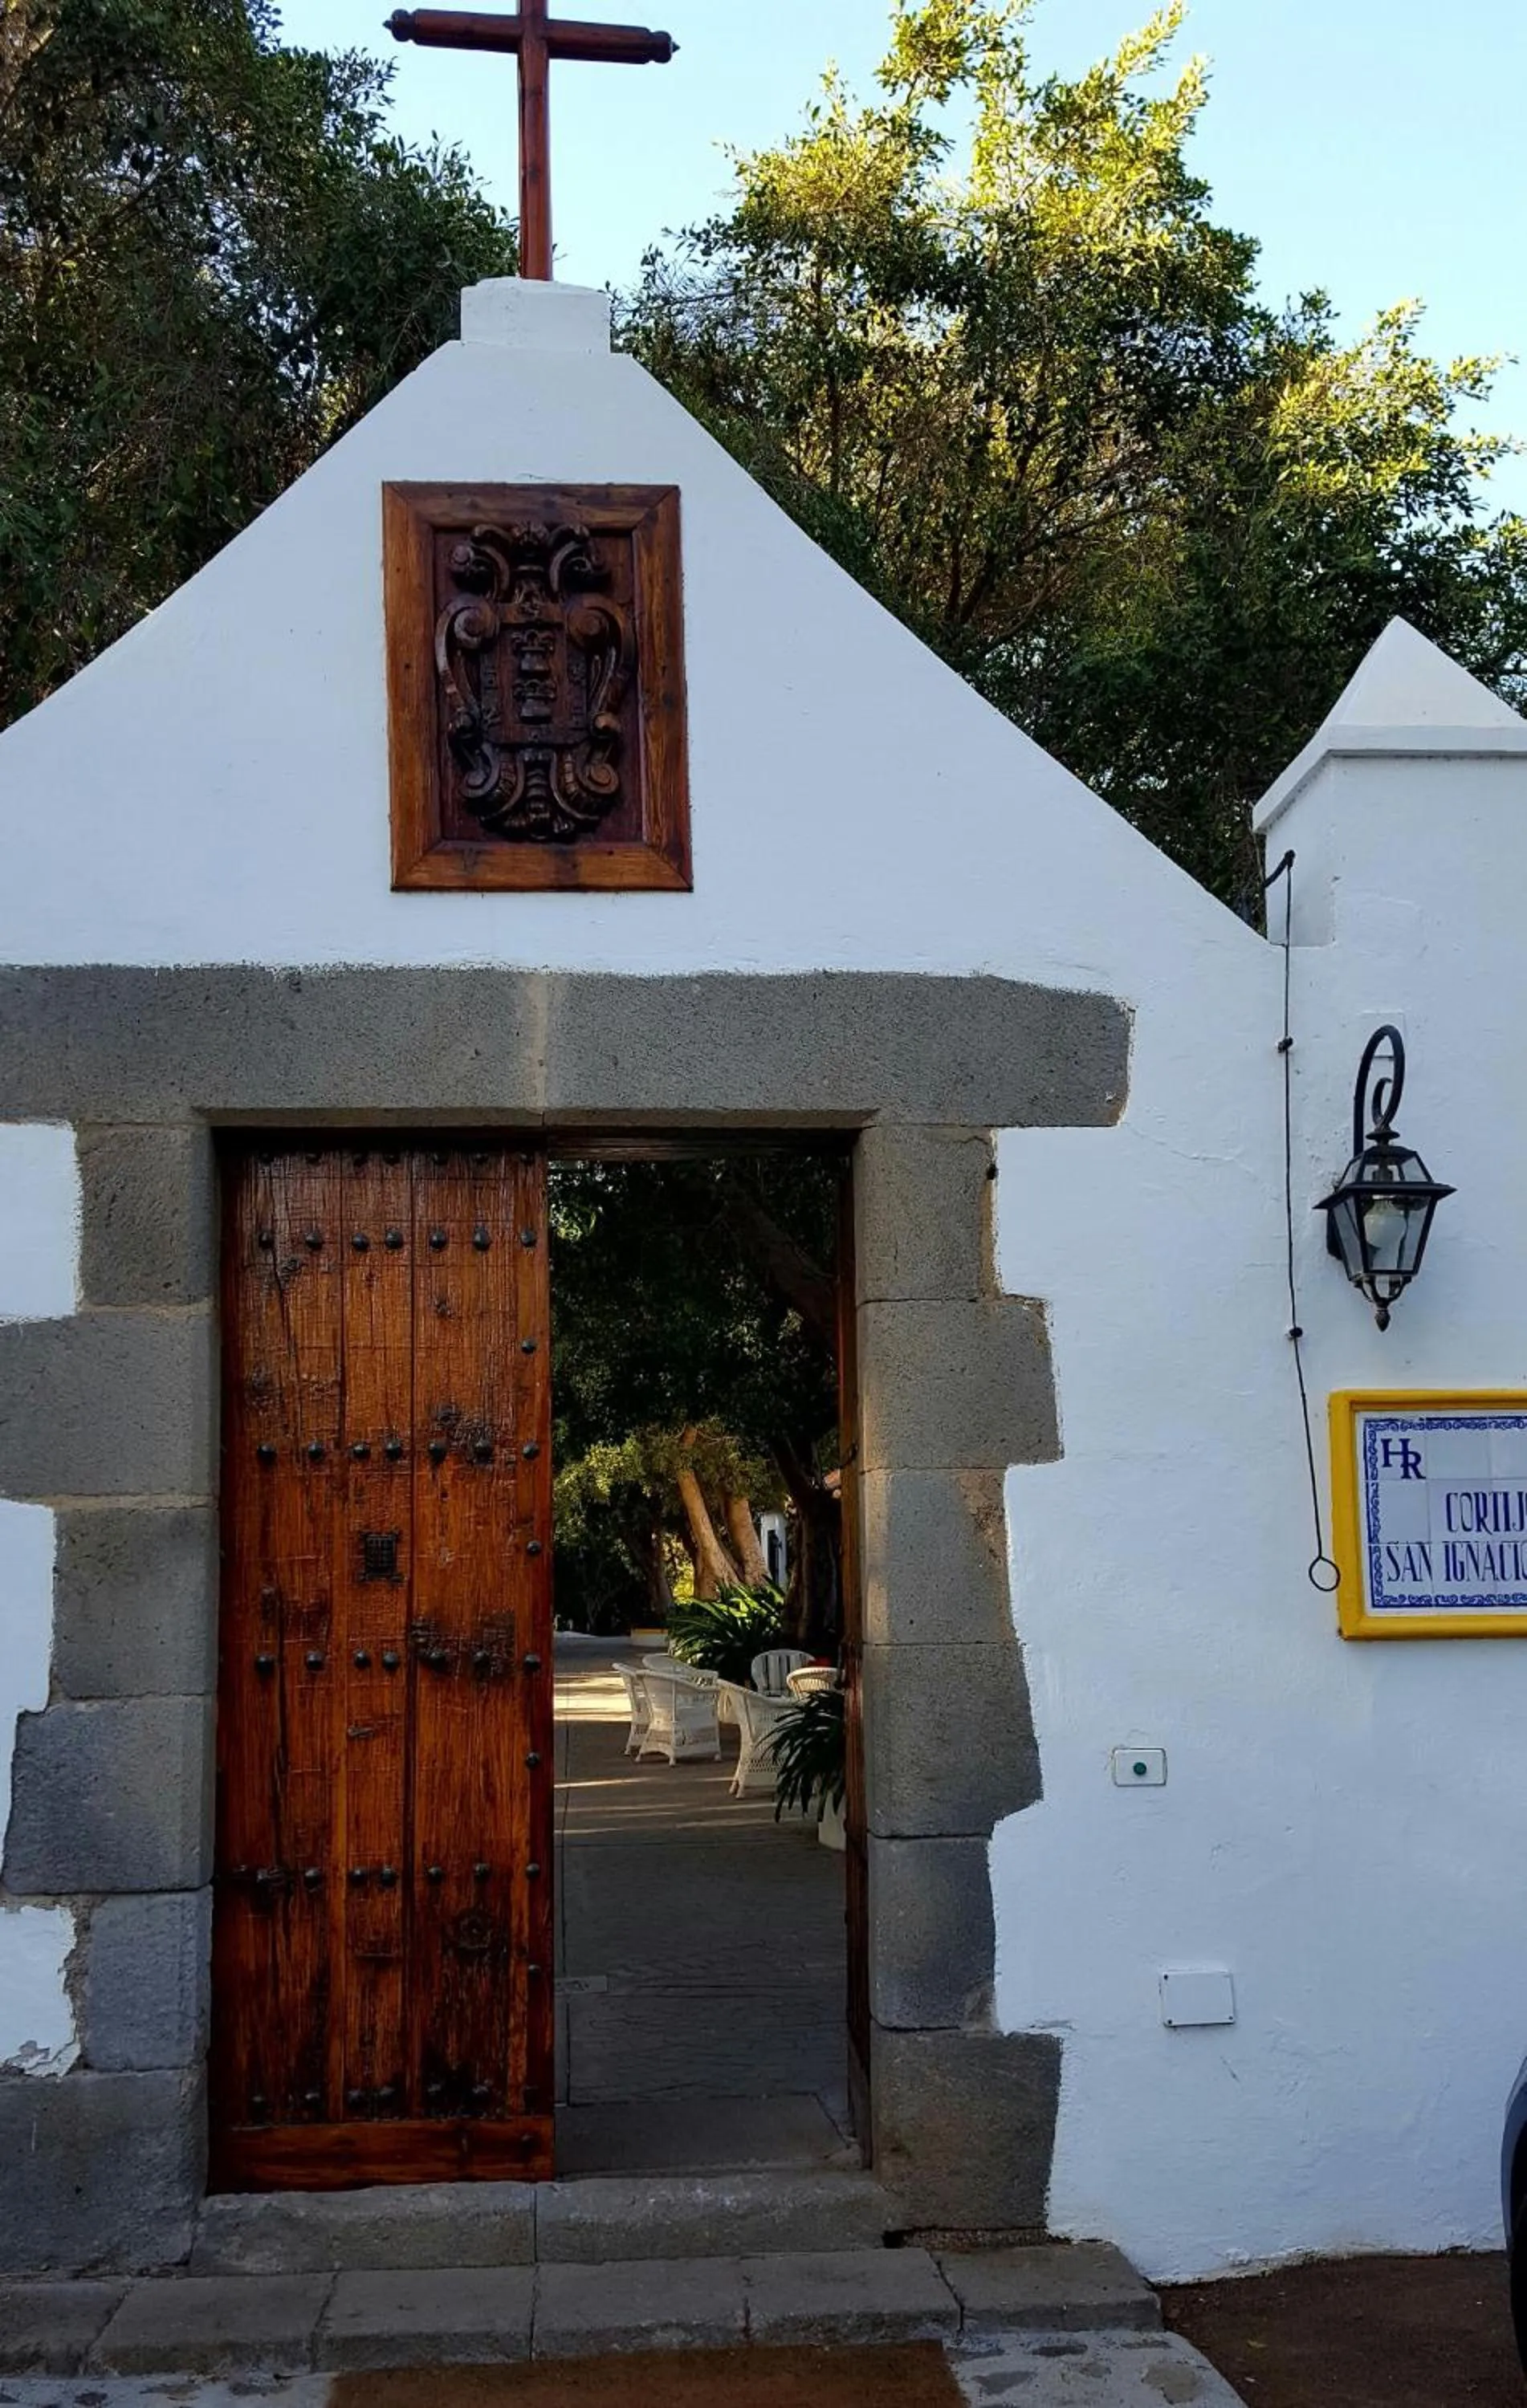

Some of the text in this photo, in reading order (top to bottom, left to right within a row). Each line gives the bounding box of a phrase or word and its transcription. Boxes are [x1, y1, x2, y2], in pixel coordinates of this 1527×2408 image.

[1380, 1438, 1427, 1479] HR
[1446, 1491, 1527, 1535] CORTIJ
[1387, 1540, 1433, 1582] SAN
